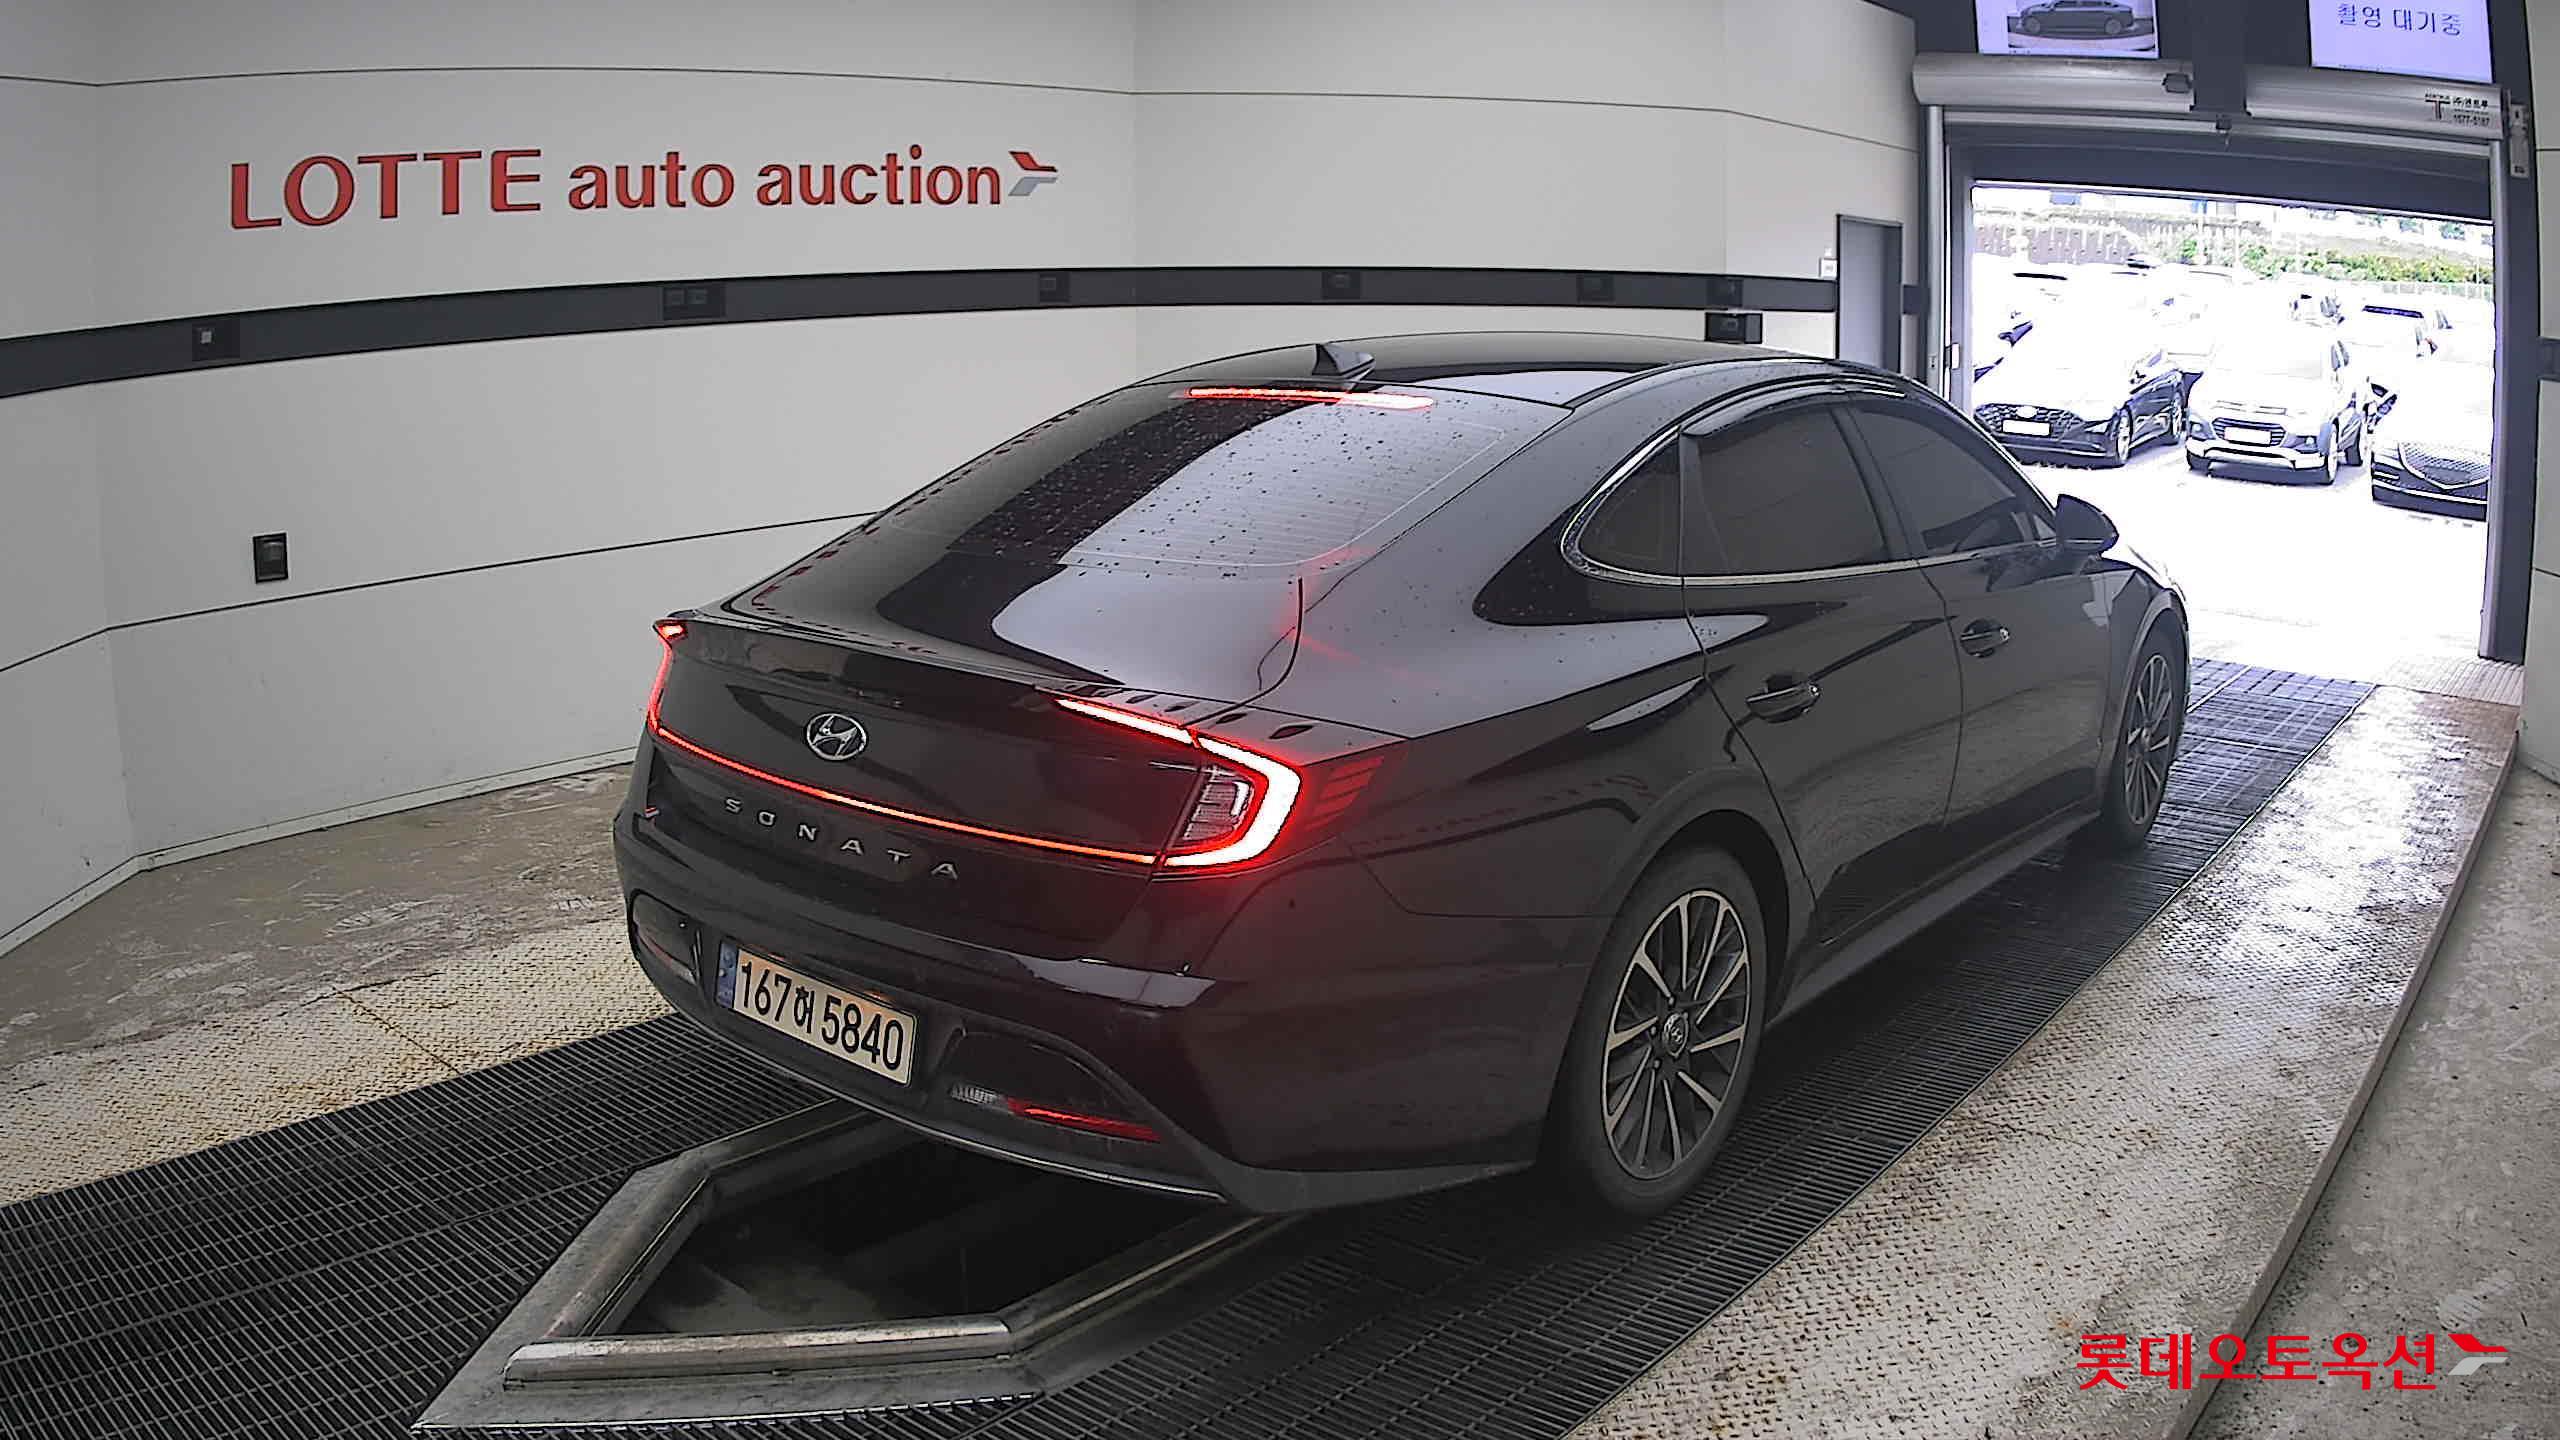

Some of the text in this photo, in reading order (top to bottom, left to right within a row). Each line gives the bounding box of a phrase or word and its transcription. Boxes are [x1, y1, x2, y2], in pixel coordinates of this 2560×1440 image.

[2338, 3, 2461, 36] 촬영 대기중
[229, 144, 1001, 230] LOTTE auto auction
[724, 798, 959, 880] SONATA
